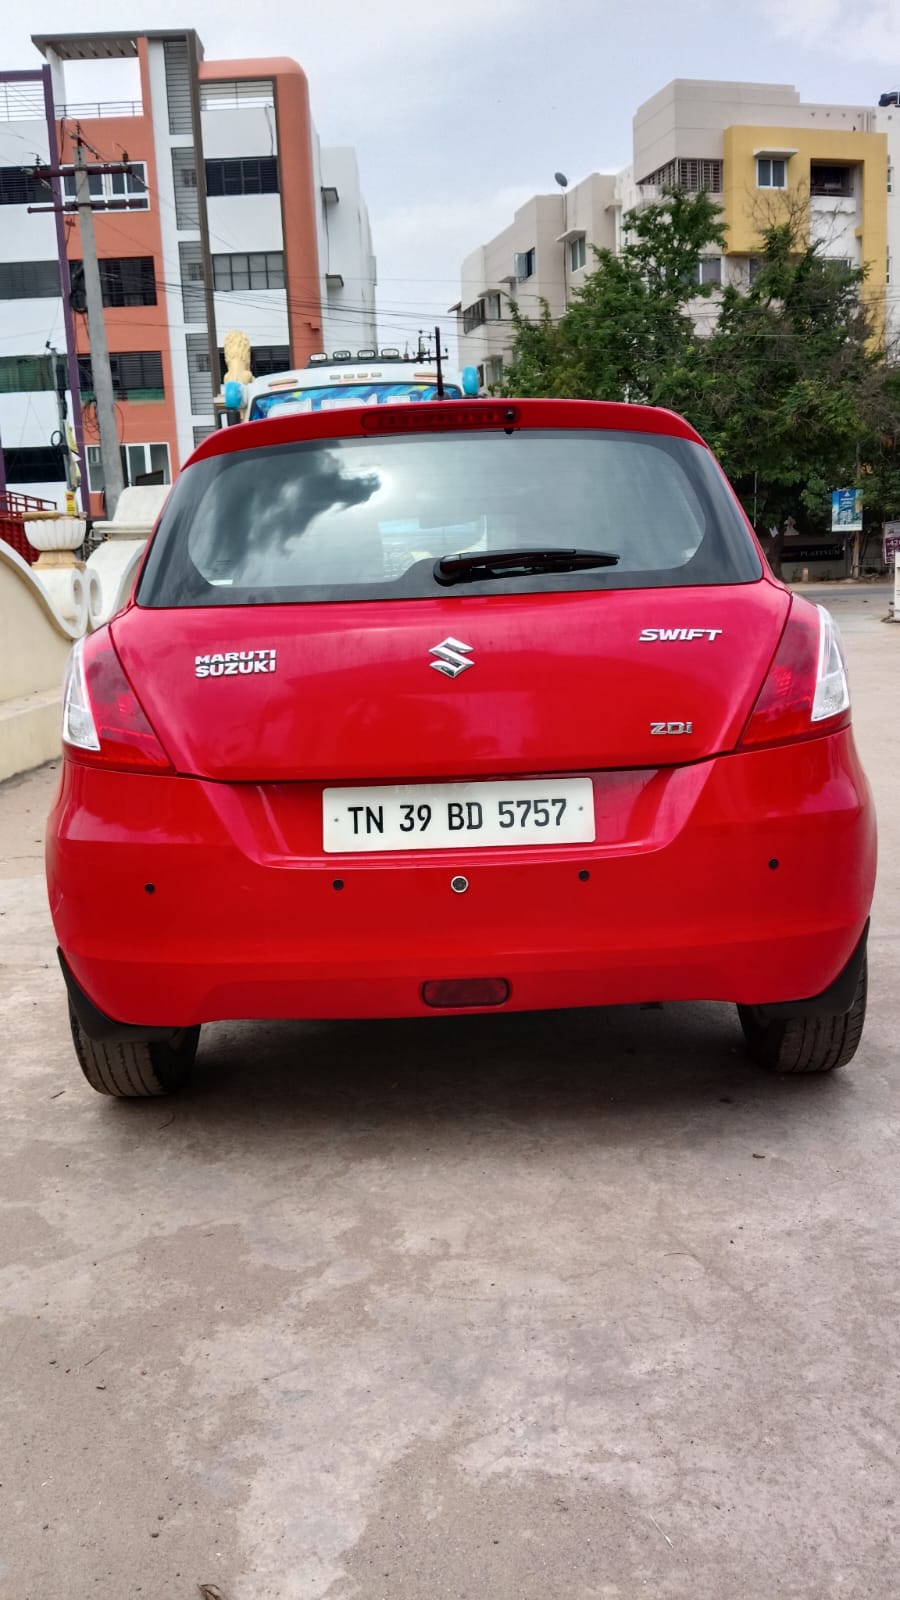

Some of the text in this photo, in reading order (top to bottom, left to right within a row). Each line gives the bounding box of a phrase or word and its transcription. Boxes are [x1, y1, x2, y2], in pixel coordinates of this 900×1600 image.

[639, 628, 722, 641] SWIFT
[195, 649, 276, 665] MARUTI
[195, 660, 276, 678] SUZUKI
[650, 721, 693, 735] ZDi
[348, 798, 567, 834] TN 39 BD 5757
